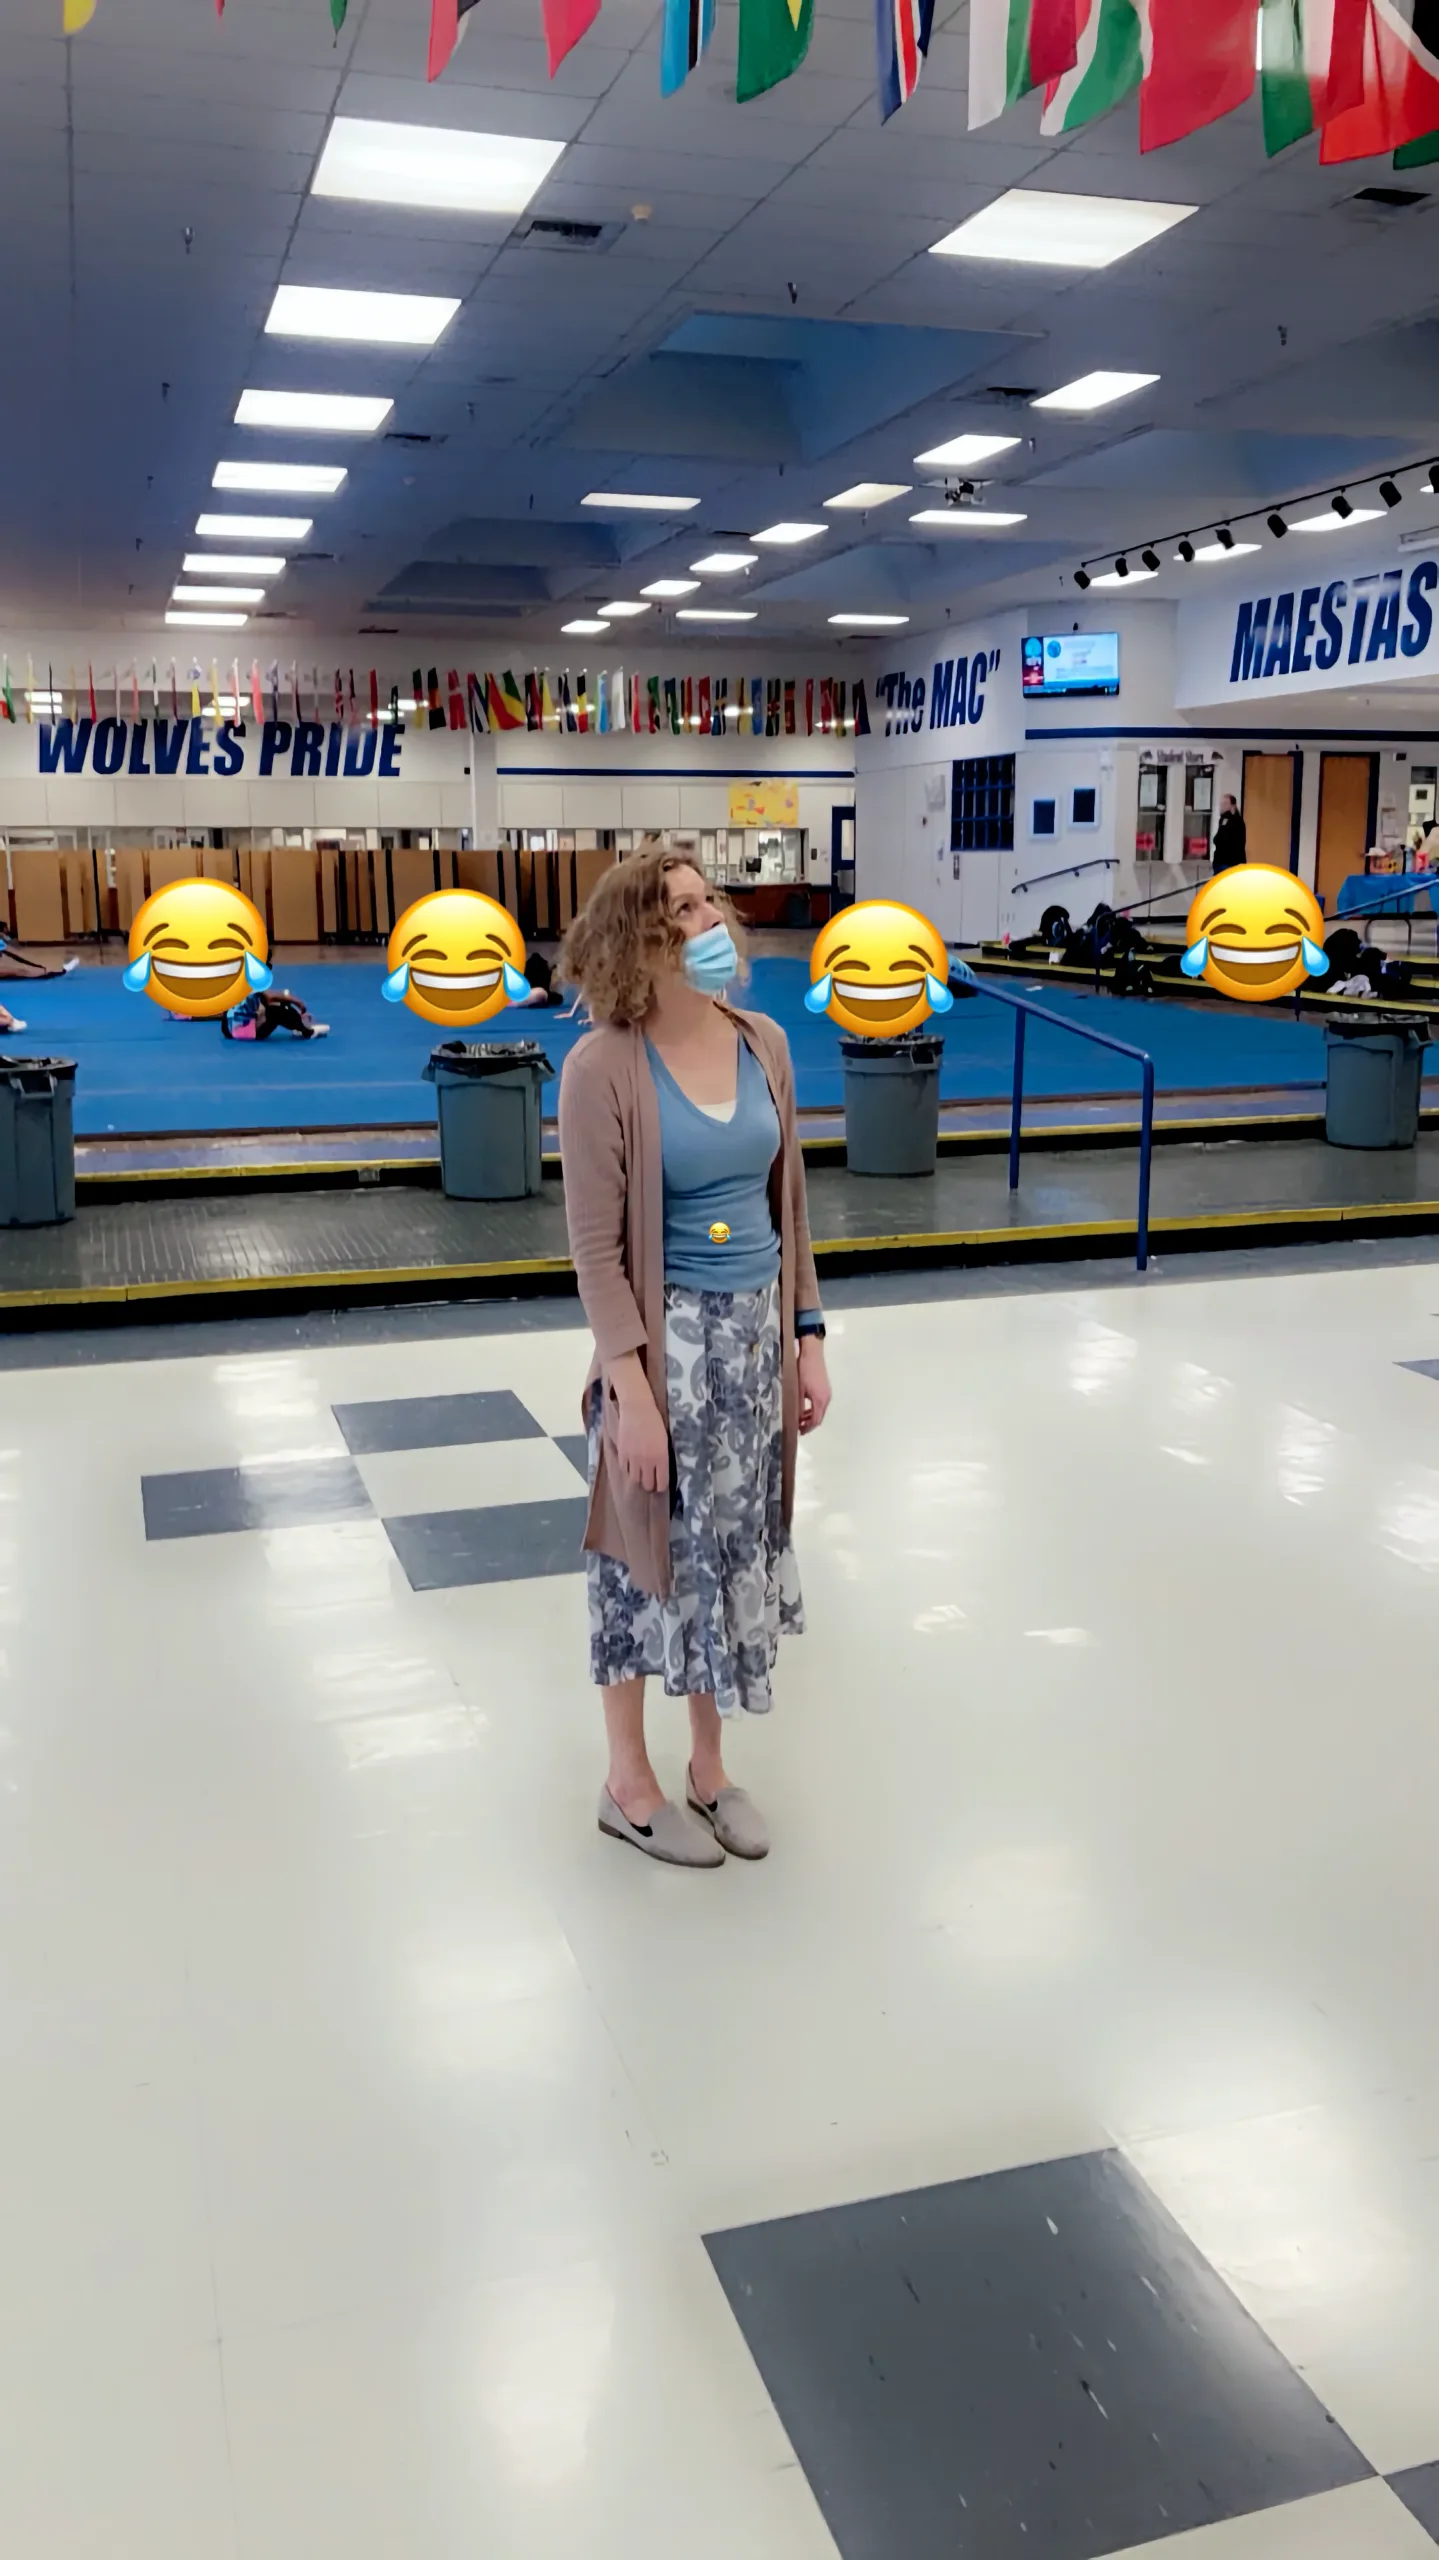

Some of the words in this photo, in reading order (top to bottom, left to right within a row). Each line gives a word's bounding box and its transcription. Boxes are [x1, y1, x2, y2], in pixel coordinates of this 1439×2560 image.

[1230, 561, 1438, 683] MAESTAS
[930, 649, 1000, 730] MAC"
[39, 716, 247, 775] WOLVES
[259, 720, 405, 777] PRIDE
